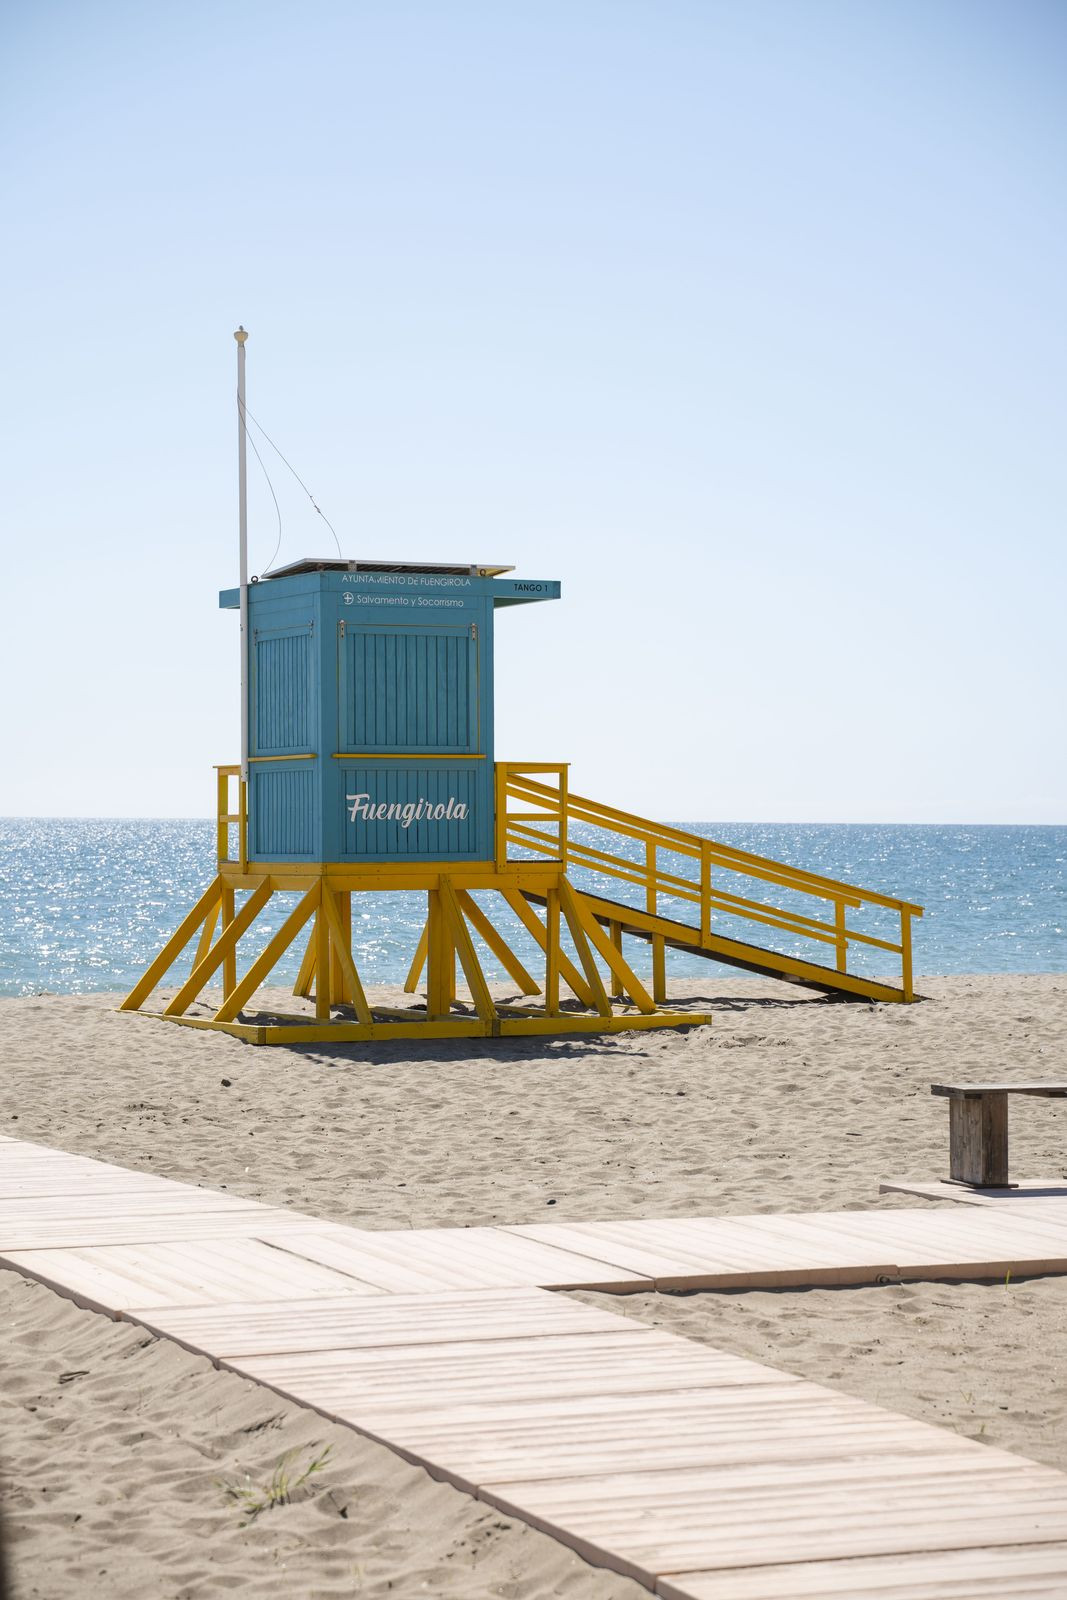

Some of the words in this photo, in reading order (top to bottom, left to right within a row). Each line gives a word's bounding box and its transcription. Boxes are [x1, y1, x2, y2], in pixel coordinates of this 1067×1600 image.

[420, 577, 472, 587] FUENGIROLA
[514, 583, 542, 592] TANGO
[357, 594, 409, 606] Salvamento
[411, 598, 416, 607] y
[417, 597, 464, 608] Socorrismo
[346, 793, 470, 829] Fuengirola
